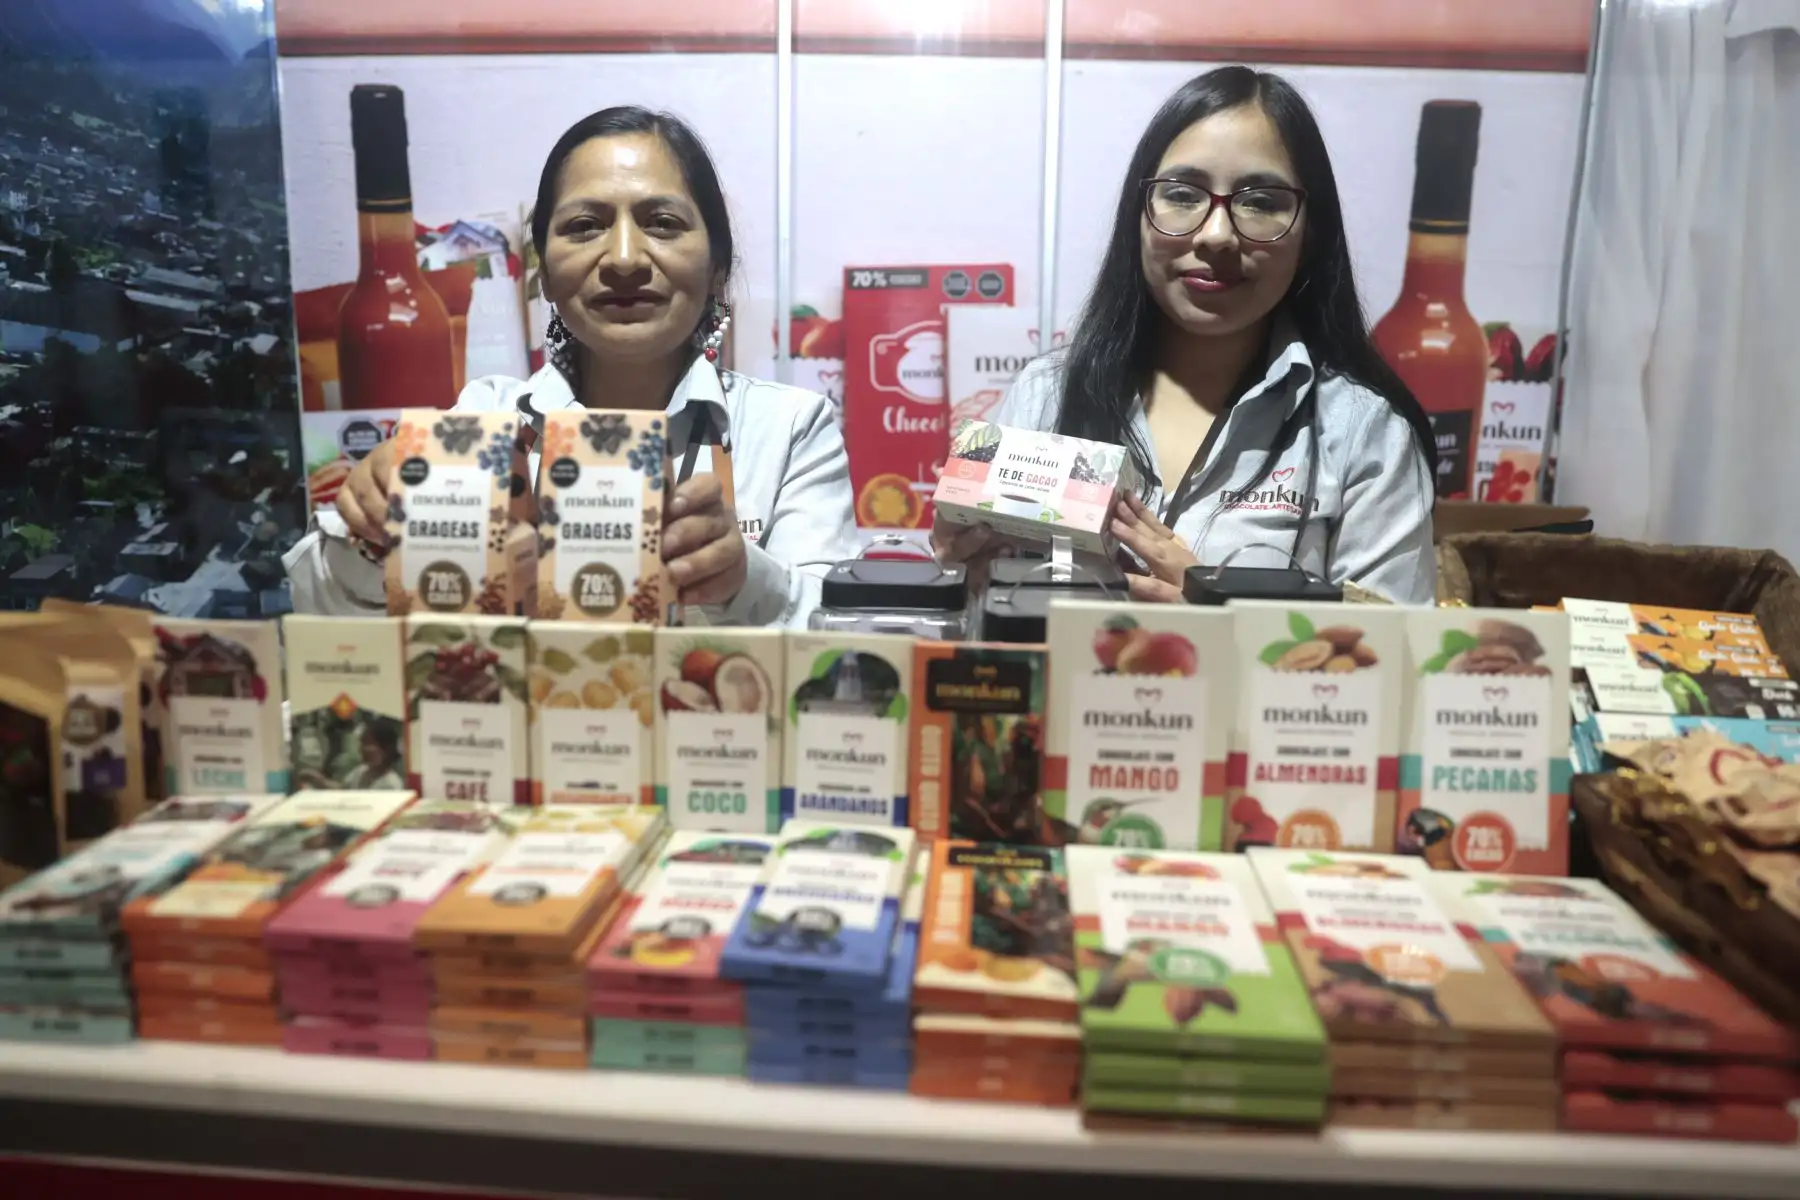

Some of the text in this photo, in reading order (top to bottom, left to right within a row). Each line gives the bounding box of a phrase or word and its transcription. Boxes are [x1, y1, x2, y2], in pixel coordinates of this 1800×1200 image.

[853, 271, 887, 288] 70%
[1011, 470, 1024, 482] DE
[1025, 473, 1058, 488] CACAO
[564, 493, 635, 509] monkun
[407, 520, 480, 539] GRAGEAS
[561, 522, 633, 541] GRAGEAS
[1083, 708, 1194, 731] monkun
[1263, 703, 1369, 726] monkun
[1435, 705, 1539, 729] monkun
[1088, 763, 1180, 792] MANGO
[1254, 761, 1368, 786] ALMENDRAS
[1431, 764, 1539, 794] PECANAS
[687, 790, 748, 814] COCO
